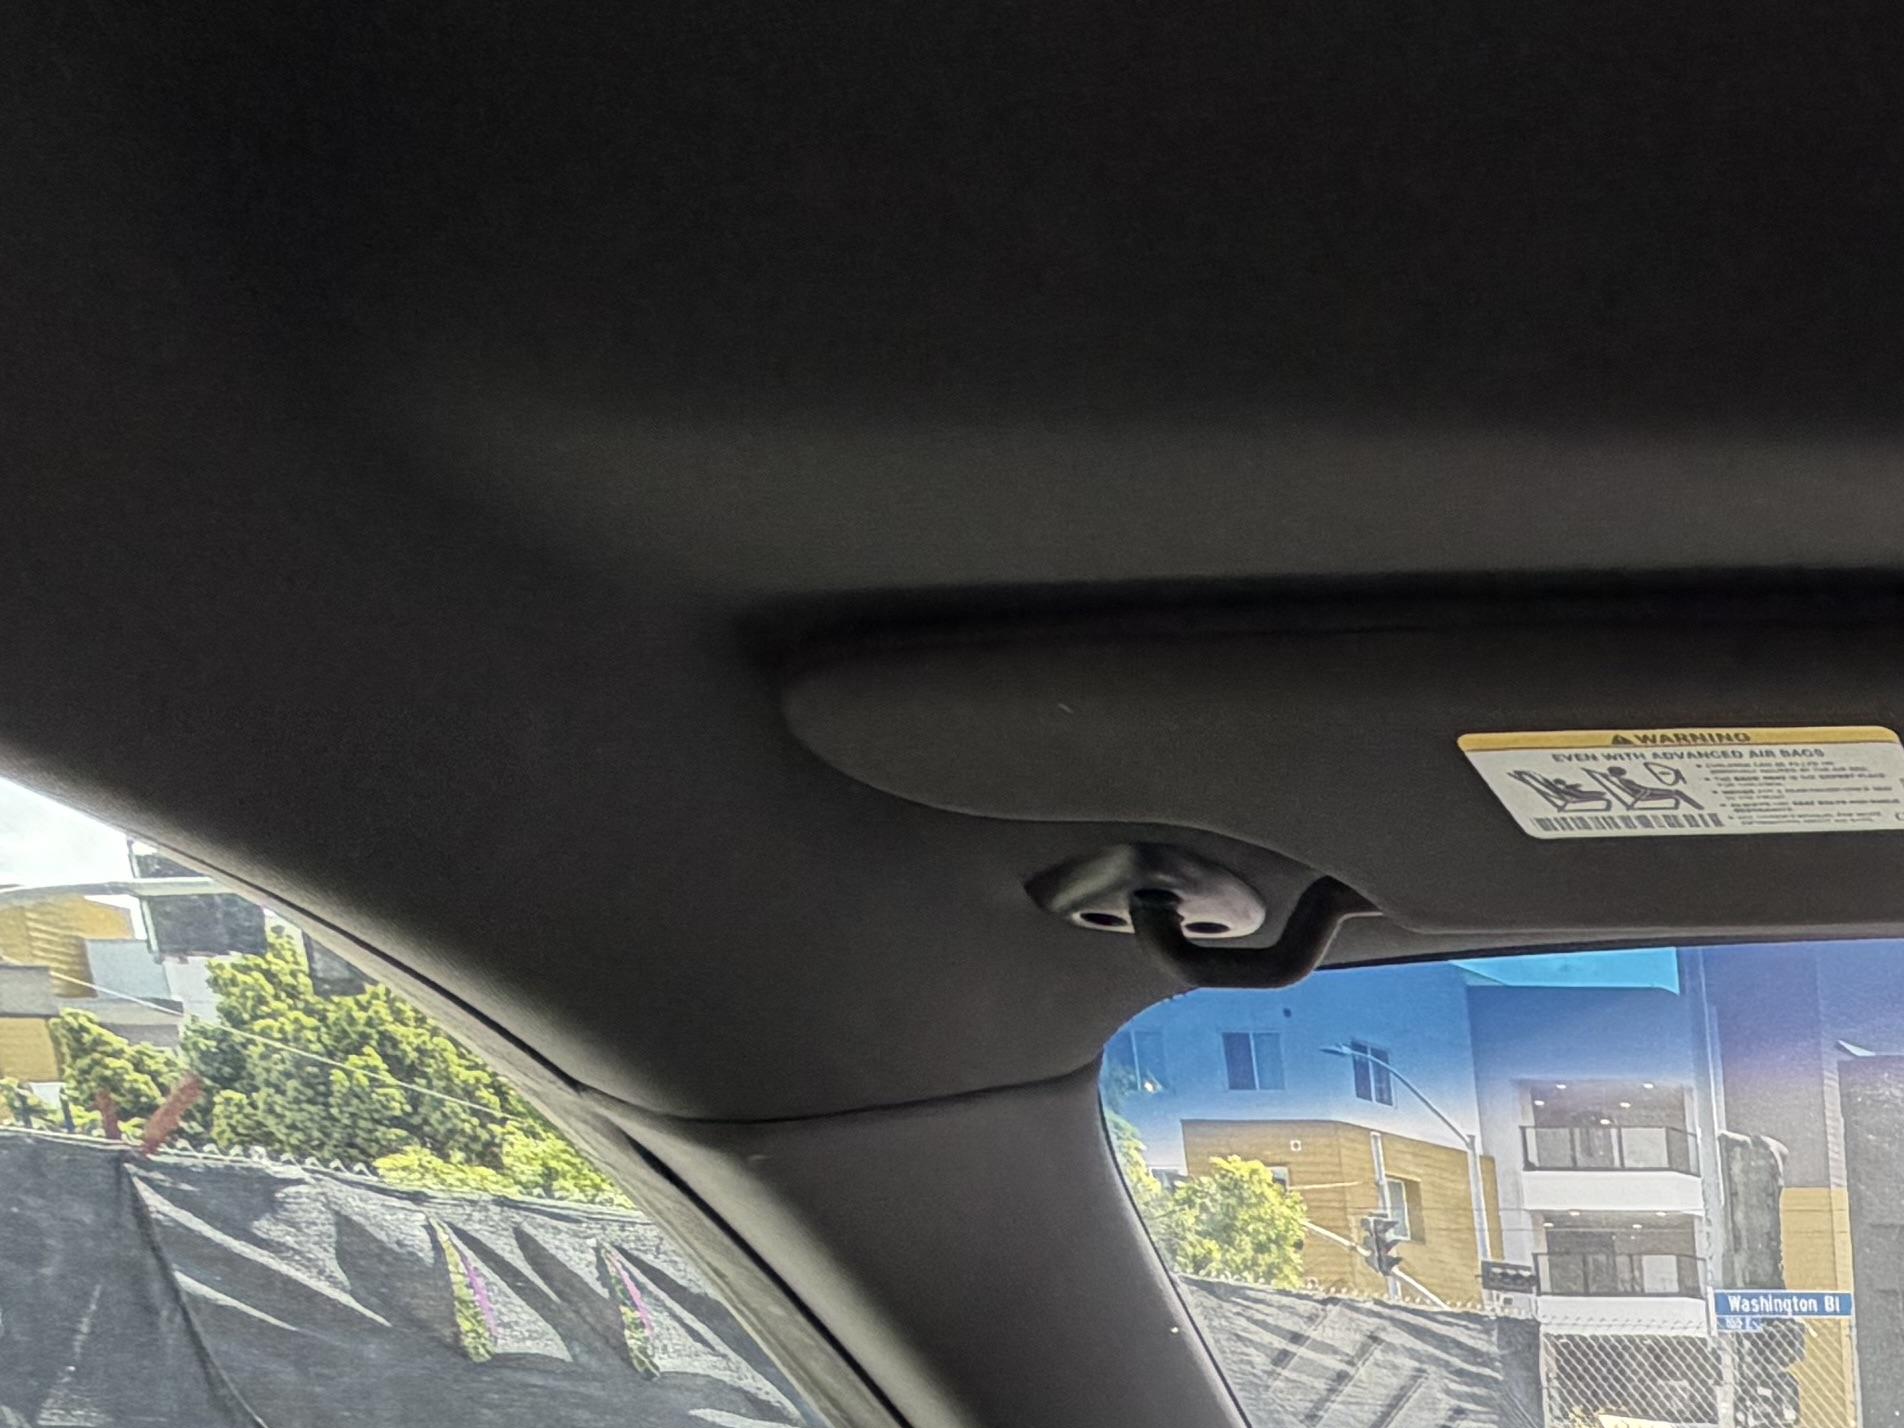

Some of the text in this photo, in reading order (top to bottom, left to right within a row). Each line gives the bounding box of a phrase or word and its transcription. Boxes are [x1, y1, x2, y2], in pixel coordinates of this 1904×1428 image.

[1633, 731, 1751, 745] WARNING
[1551, 748, 1825, 763] EVEN WITH ADVANCED AIR BAGS
[1727, 1294, 1818, 1316] Washington
